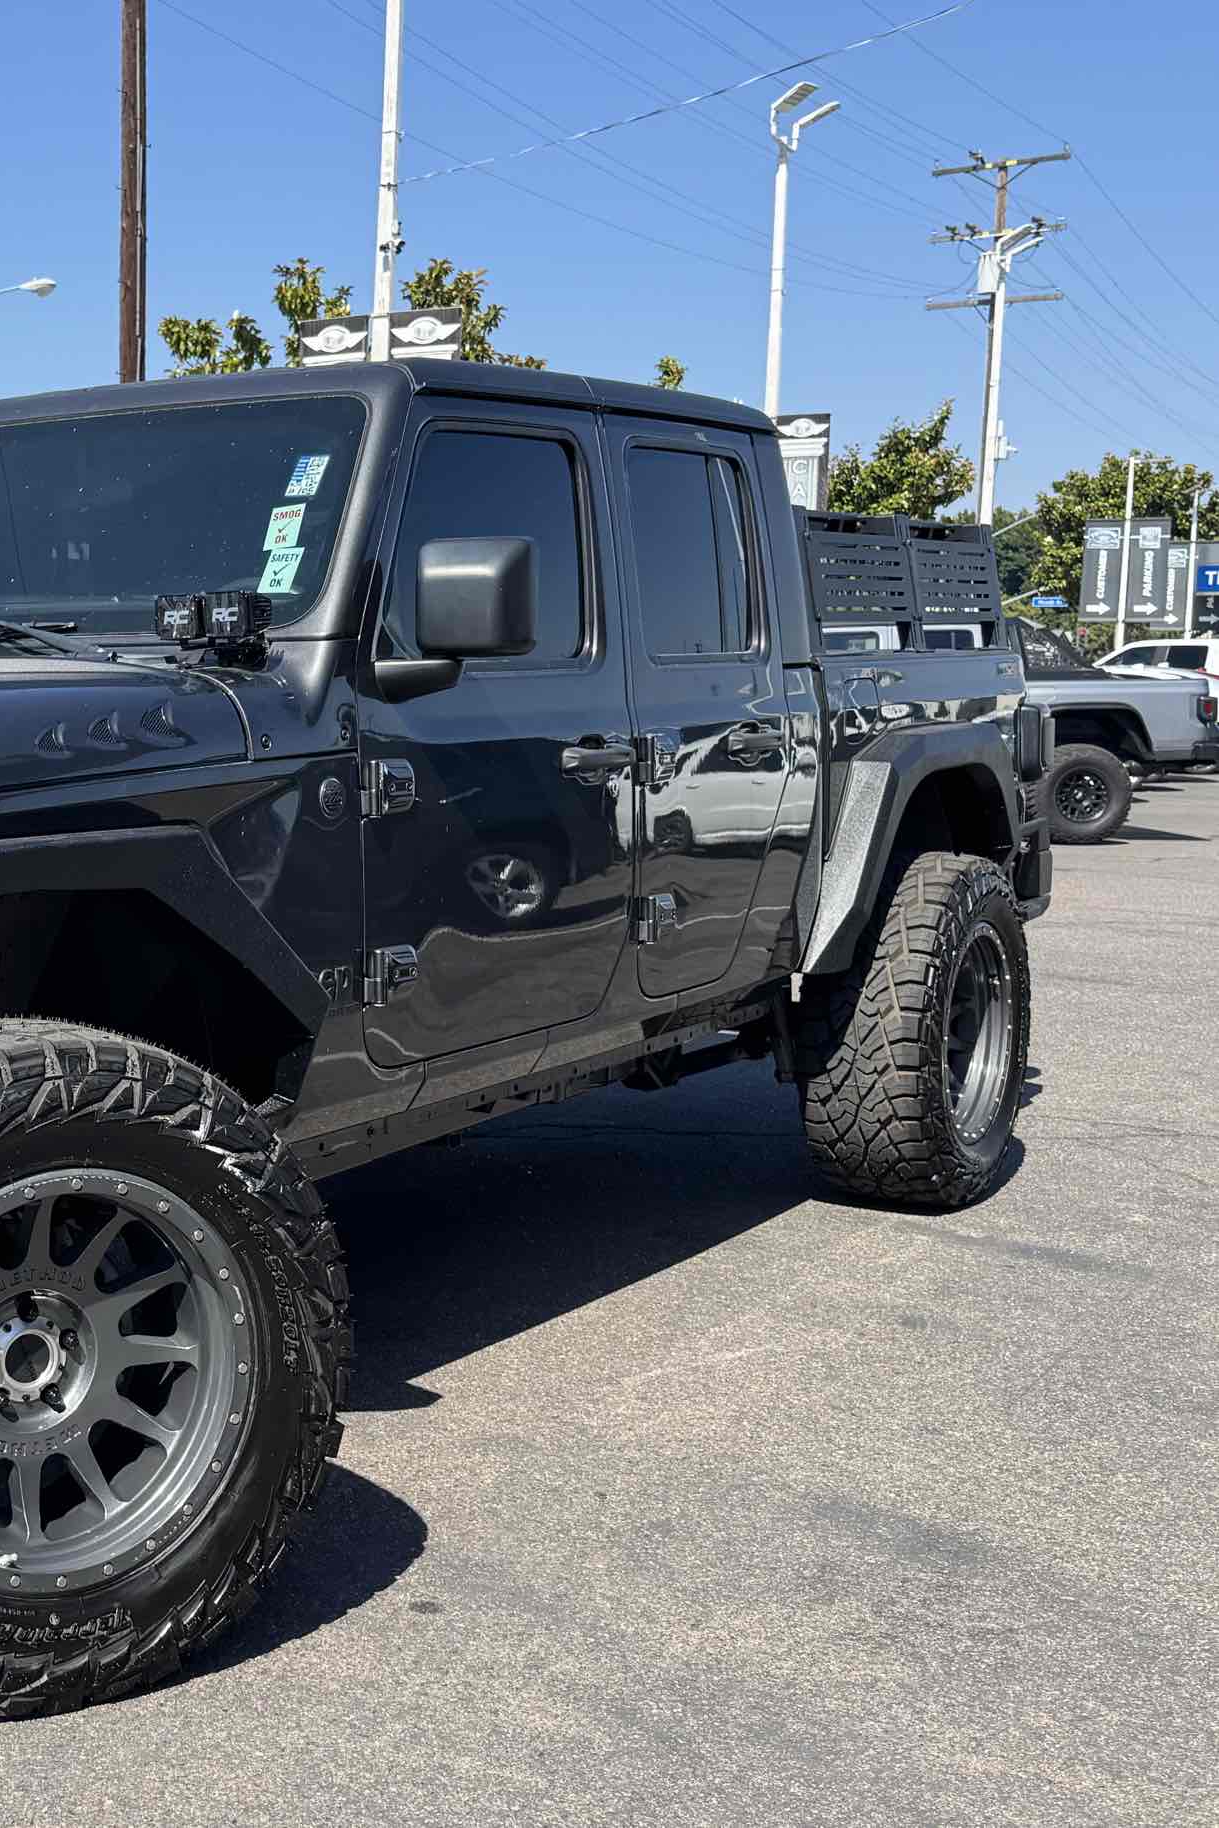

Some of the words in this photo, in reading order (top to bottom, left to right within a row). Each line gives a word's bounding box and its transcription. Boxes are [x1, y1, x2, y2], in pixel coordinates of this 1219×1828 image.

[272, 508, 302, 522] SMOG
[274, 534, 288, 545] OK
[270, 553, 300, 563] SAFETY
[1142, 550, 1155, 597] PARKING
[269, 578, 284, 588] OK
[163, 609, 190, 625] RC
[211, 606, 239, 623] RC
